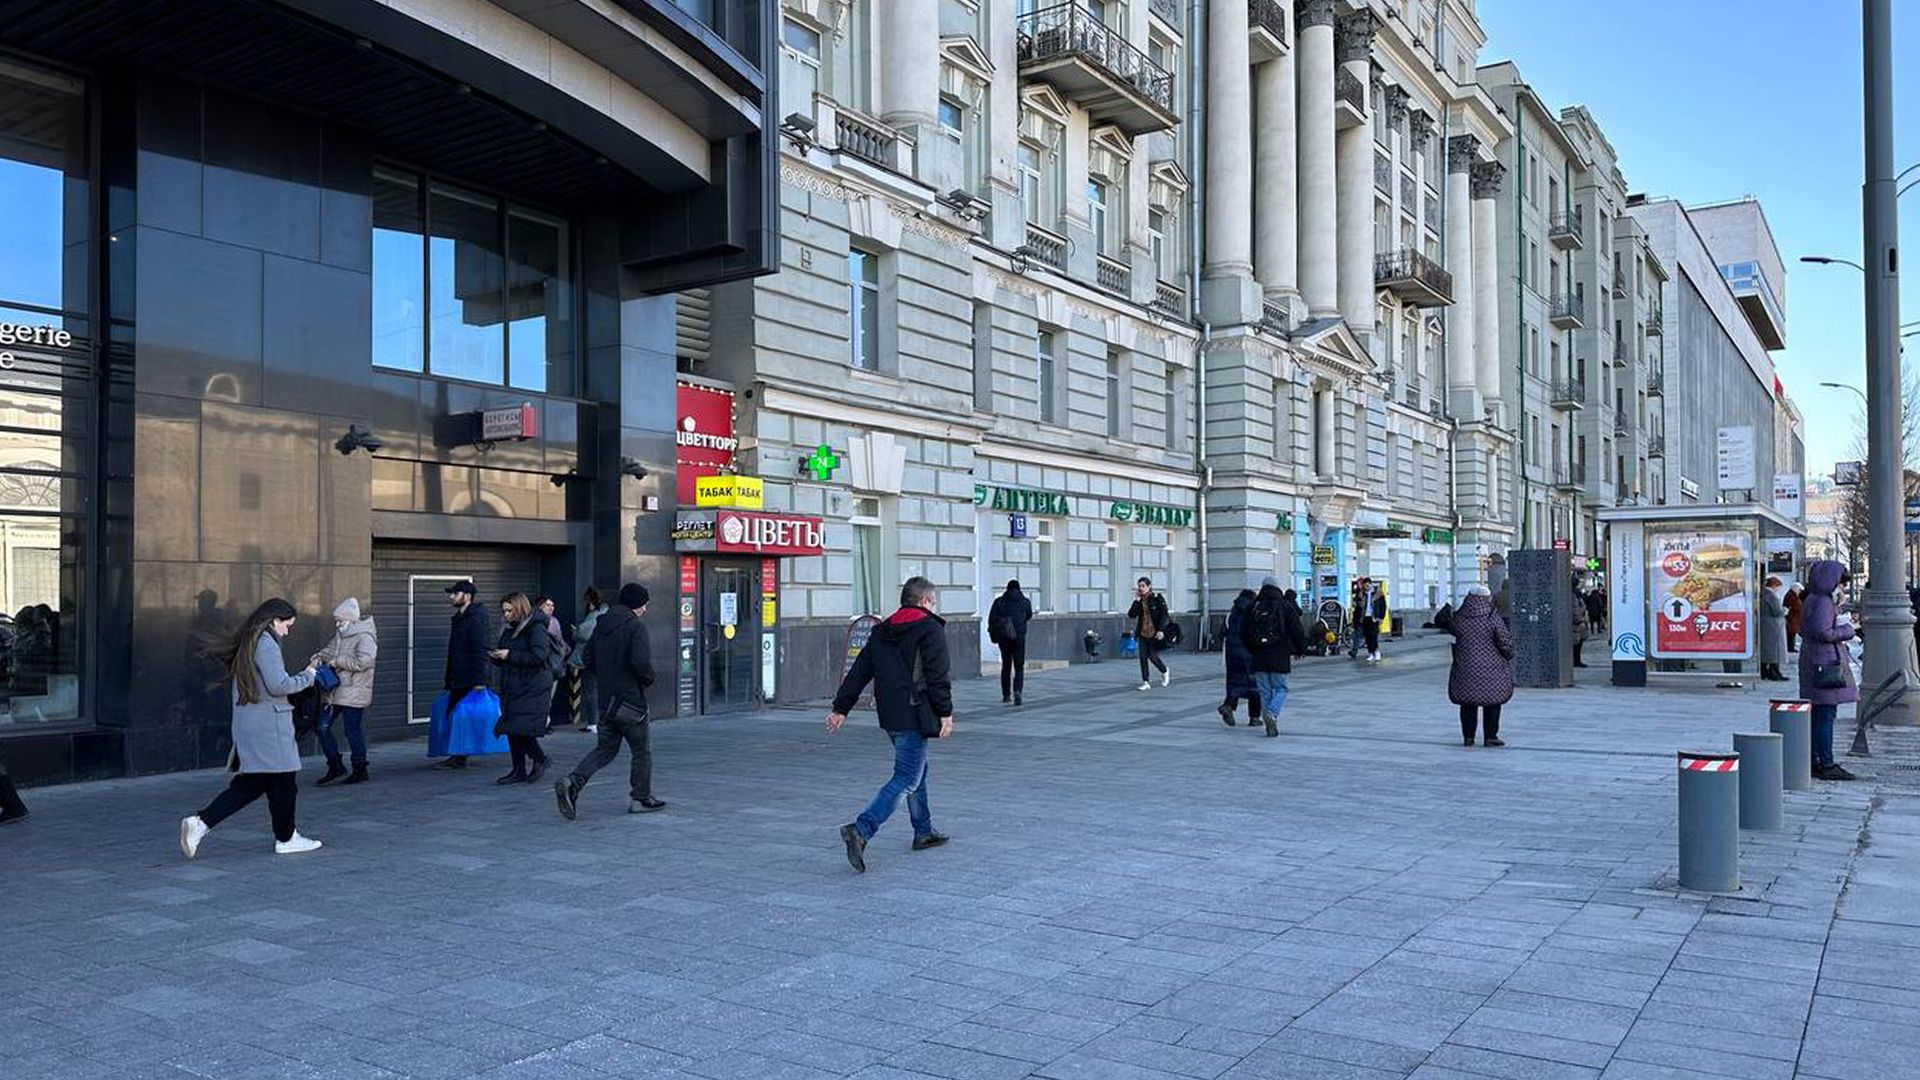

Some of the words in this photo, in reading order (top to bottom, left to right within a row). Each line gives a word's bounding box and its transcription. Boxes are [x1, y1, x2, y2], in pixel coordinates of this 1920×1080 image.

[699, 487, 733, 497] ТАБАК
[736, 487, 761, 498] ТАБАК
[992, 486, 1071, 516] АПТЕКА
[676, 520, 713, 531] РЕГЛЕТ
[1016, 516, 1025, 530] 13
[744, 517, 826, 551] ЦВЕТЫ
[1710, 621, 1741, 631] KFC
